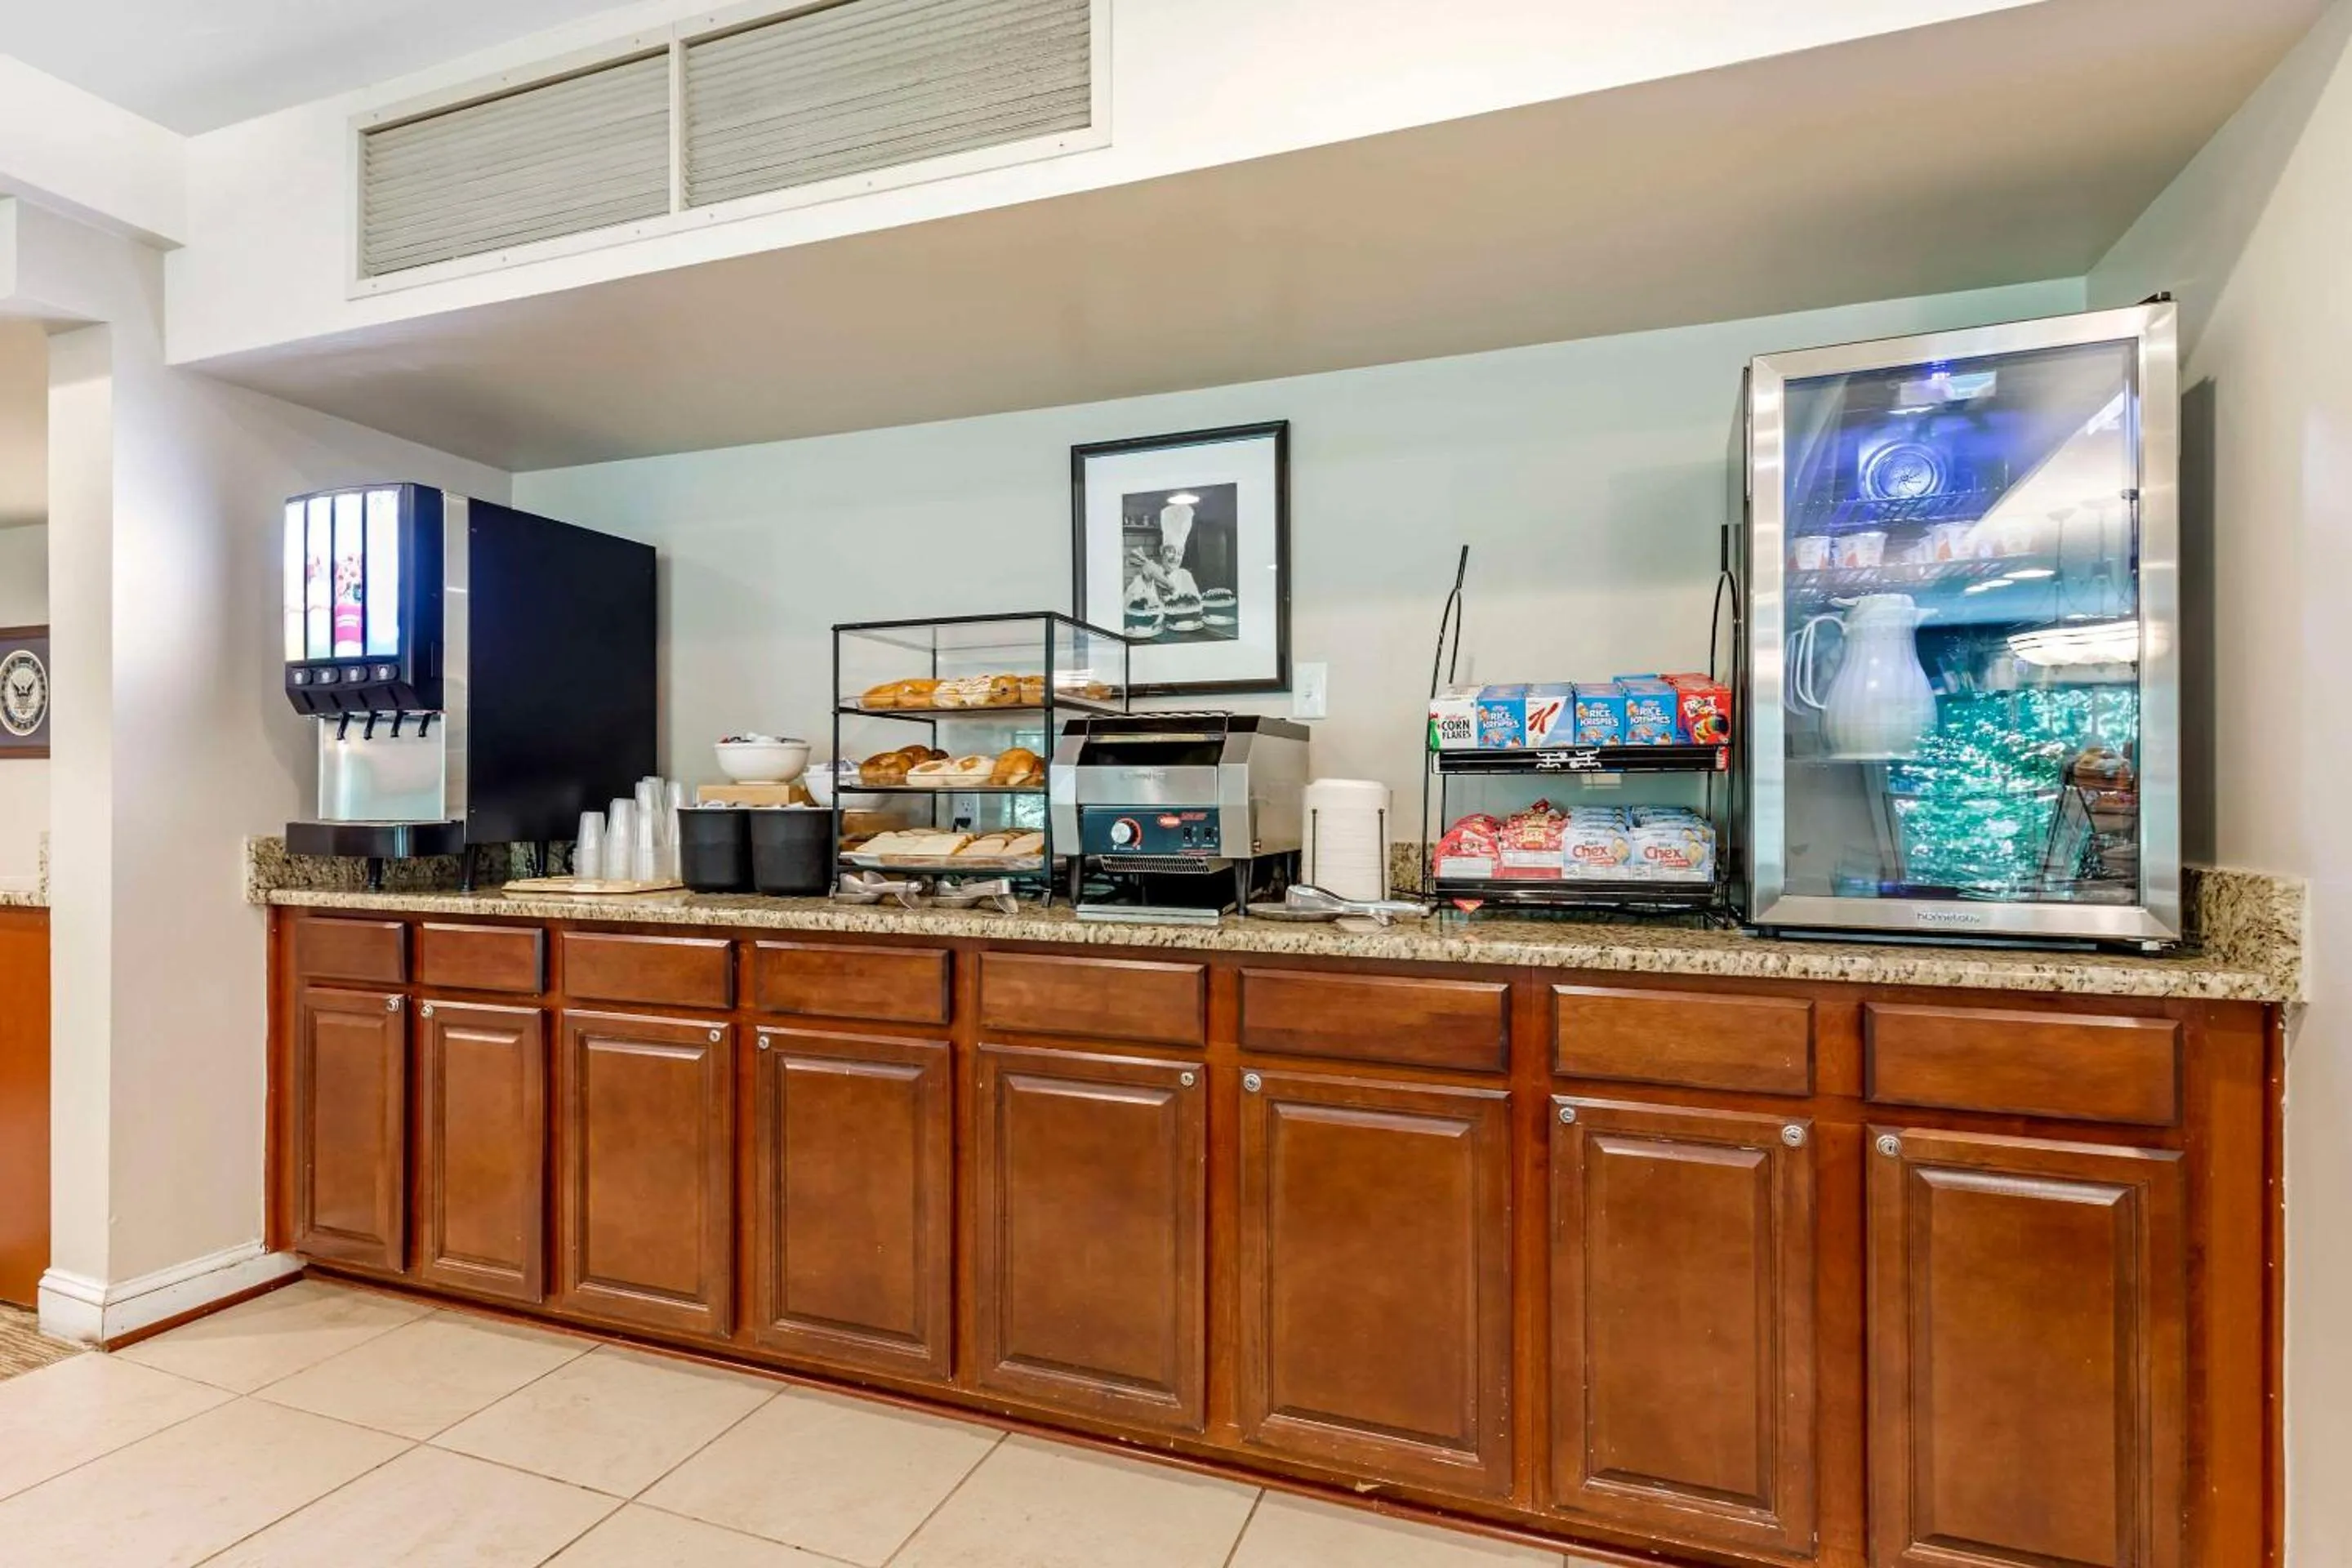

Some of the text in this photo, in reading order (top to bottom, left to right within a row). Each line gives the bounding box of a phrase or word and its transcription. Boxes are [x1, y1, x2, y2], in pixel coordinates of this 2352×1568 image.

[1490, 711, 1512, 720] RICE
[1589, 709, 1611, 718] RICE
[1441, 719, 1470, 731] CORN
[1441, 730, 1472, 740] FLAKES
[1573, 844, 1609, 858] Chex
[1644, 845, 1682, 860] Chex
